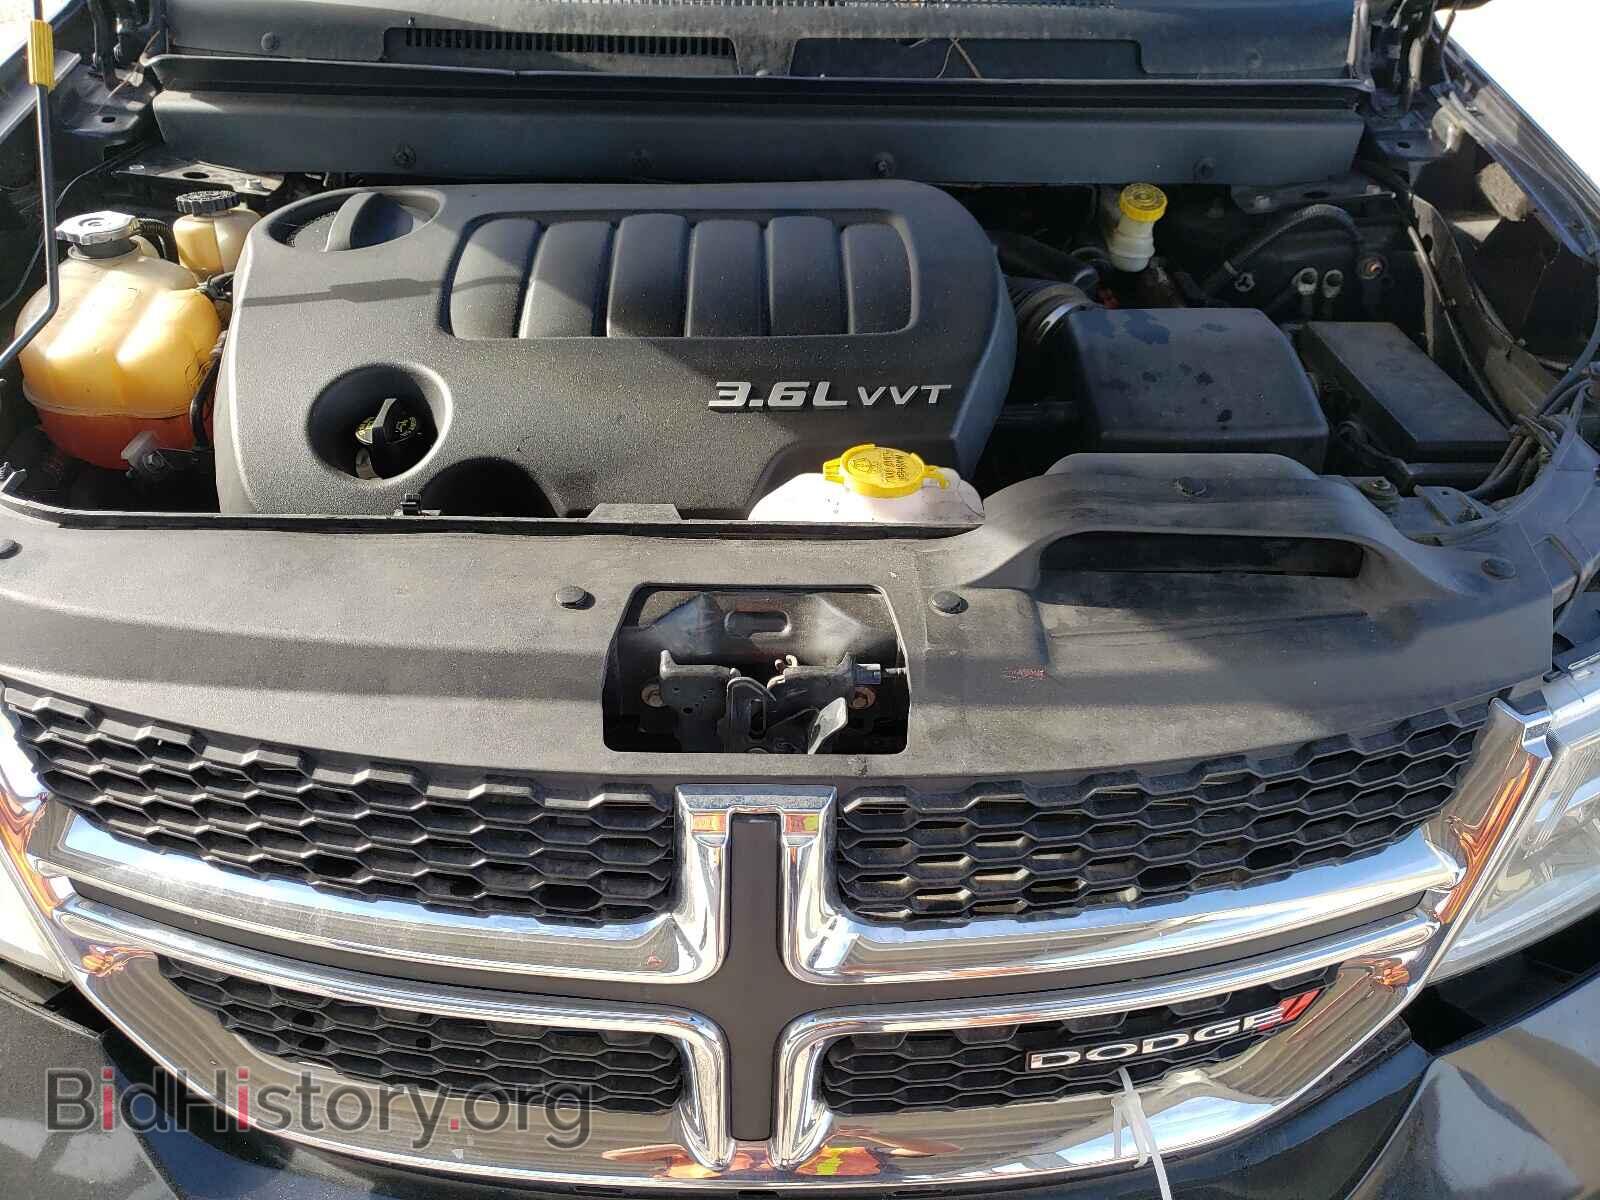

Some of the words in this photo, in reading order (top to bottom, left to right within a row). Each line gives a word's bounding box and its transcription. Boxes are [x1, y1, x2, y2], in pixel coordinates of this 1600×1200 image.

[708, 381, 848, 407] 3.6L
[858, 384, 952, 406] VVT
[1030, 1007, 1285, 1070] DODGE
